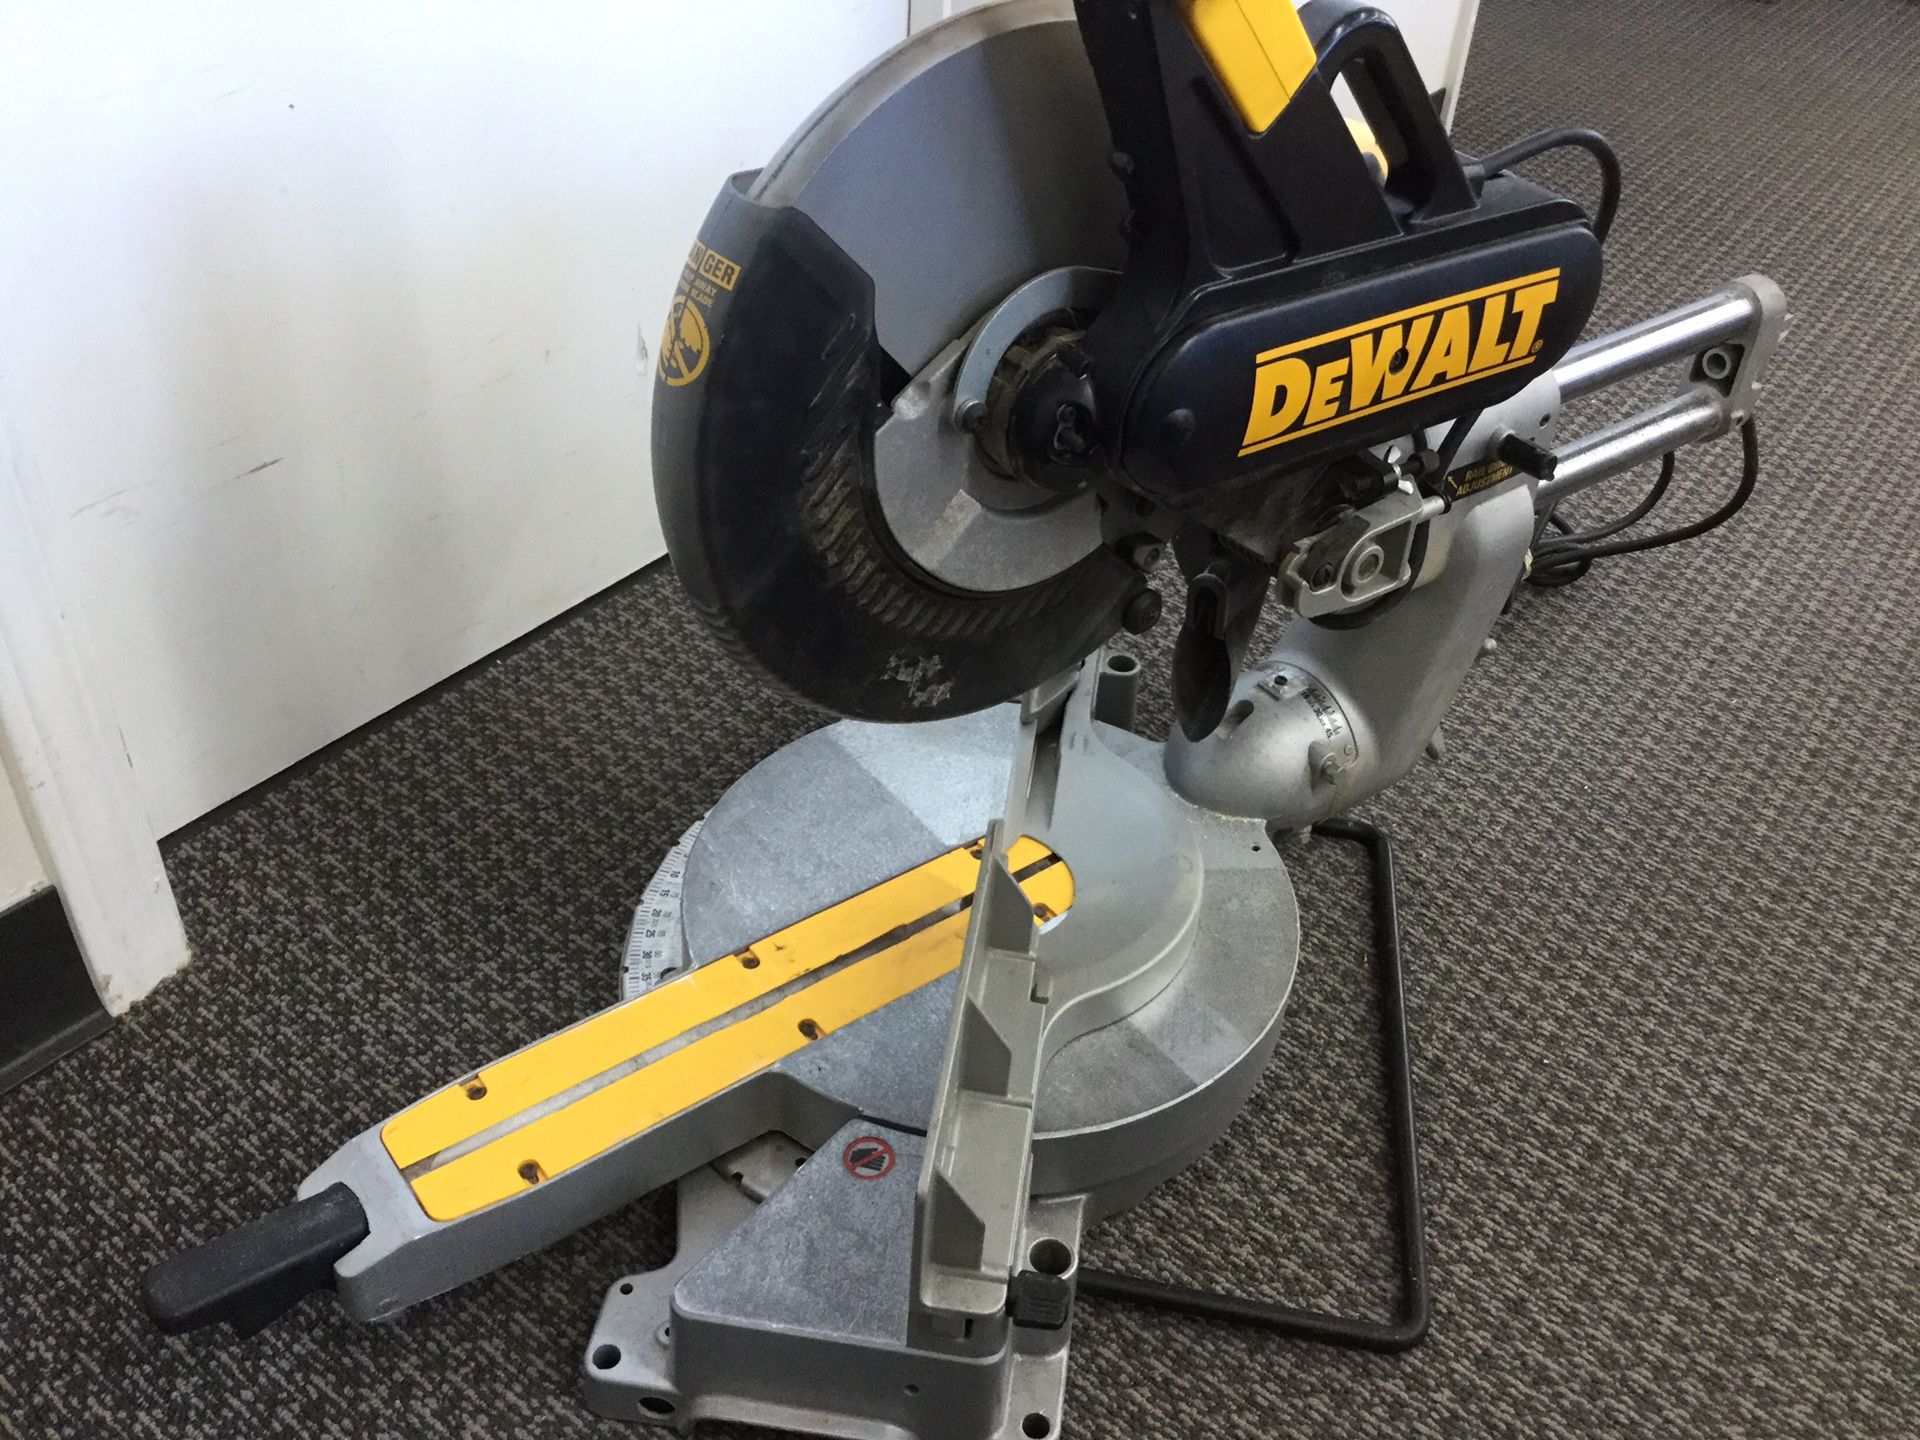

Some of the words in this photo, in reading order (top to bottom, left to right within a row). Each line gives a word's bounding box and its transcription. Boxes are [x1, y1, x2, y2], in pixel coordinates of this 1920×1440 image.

[660, 889, 671, 897] 15
[651, 908, 662, 918] 20
[645, 929, 656, 938] 25
[642, 950, 653, 959] 30
[641, 972, 652, 981] 35
